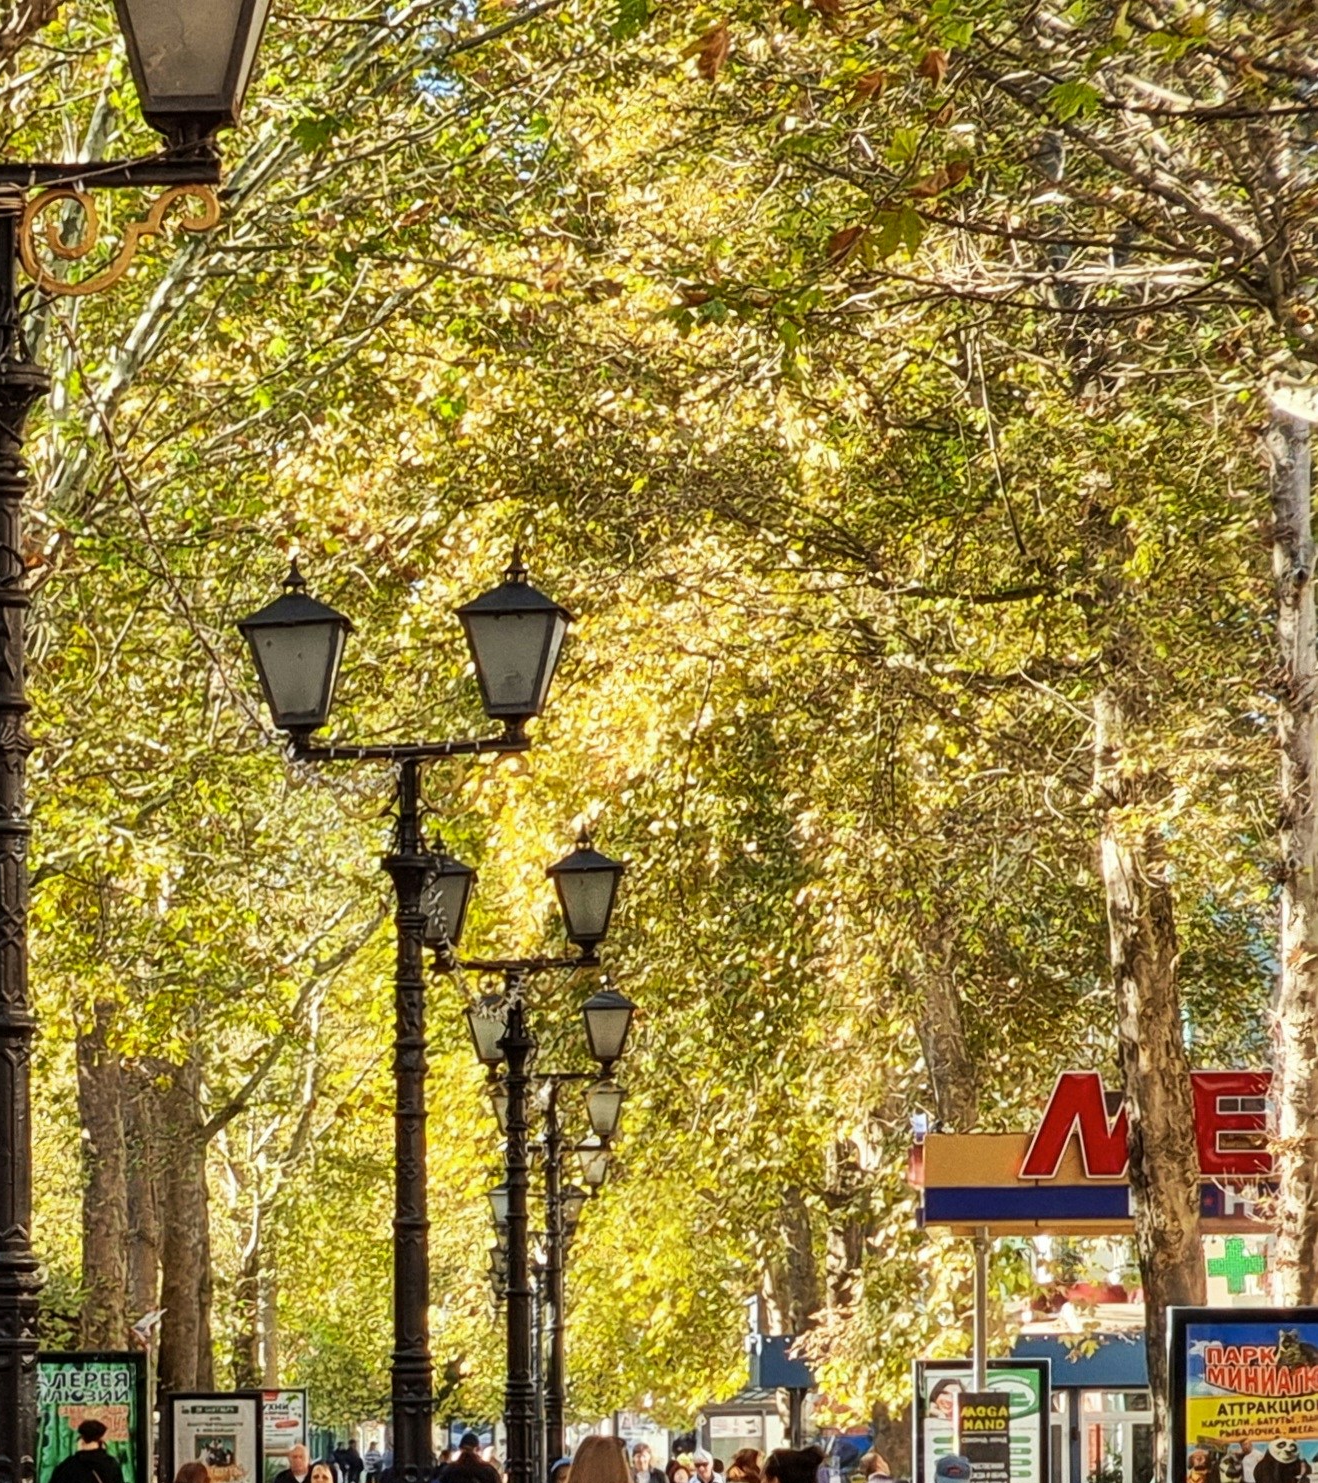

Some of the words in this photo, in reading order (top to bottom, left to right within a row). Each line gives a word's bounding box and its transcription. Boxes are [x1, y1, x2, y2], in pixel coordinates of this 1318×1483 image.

[1205, 1346, 1276, 1366] ПАРК
[1217, 1399, 1318, 1417] АТТРАКЦИО
[963, 1419, 1006, 1430] HAND
